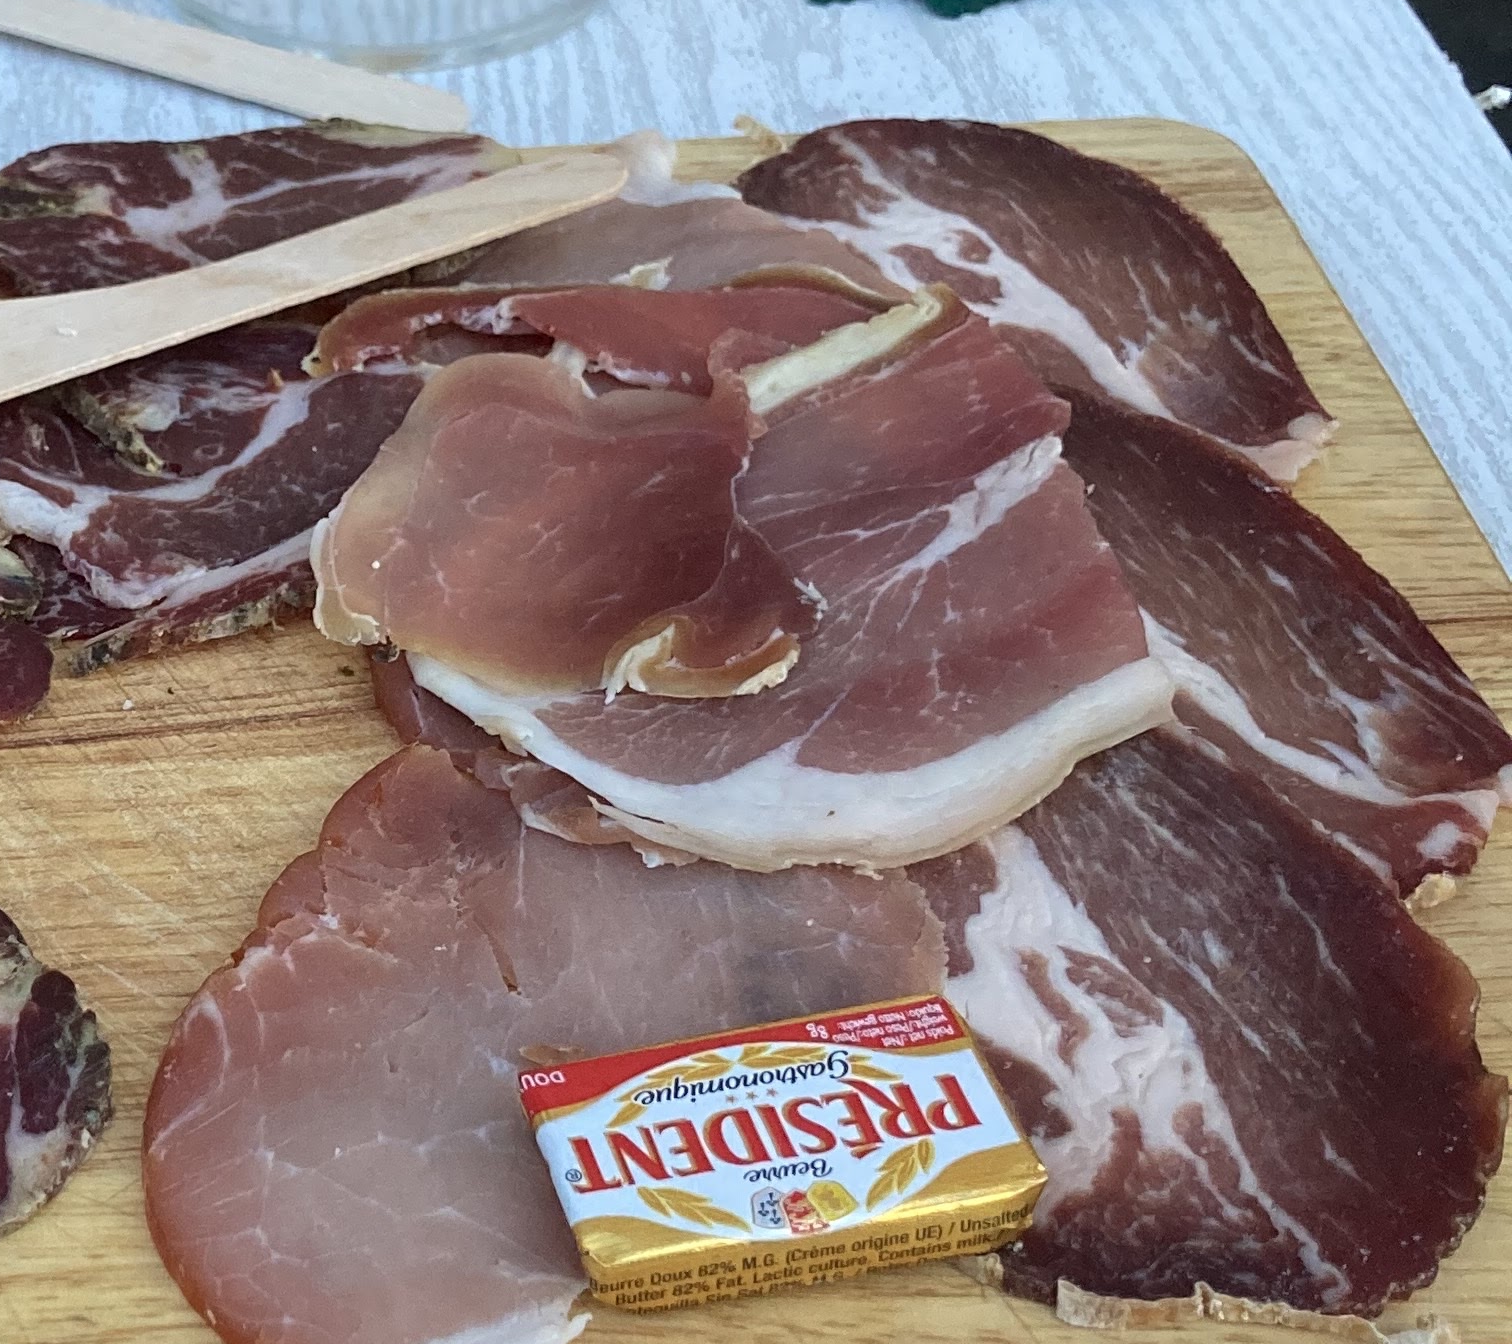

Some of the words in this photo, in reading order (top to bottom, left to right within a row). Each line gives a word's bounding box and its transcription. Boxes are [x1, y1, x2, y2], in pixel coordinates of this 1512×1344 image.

[805, 1022, 830, 1040] 8g
[520, 1070, 566, 1092] DOU
[631, 1048, 852, 1108] Gastronomique
[567, 1073, 984, 1194] PRÉSIDENT
[742, 1158, 834, 1184] Beurre
[615, 1288, 667, 1306] Butter
[672, 1280, 711, 1297] 82%
[752, 1266, 804, 1284] Lactic
[878, 1241, 952, 1262] Contains
[650, 1268, 693, 1286] Doux
[697, 1259, 737, 1277] 82%
[742, 1253, 779, 1270] M.G.
[851, 1231, 910, 1252] origine
[915, 1224, 943, 1242] UE)
[960, 1203, 1029, 1233] Unsalted
